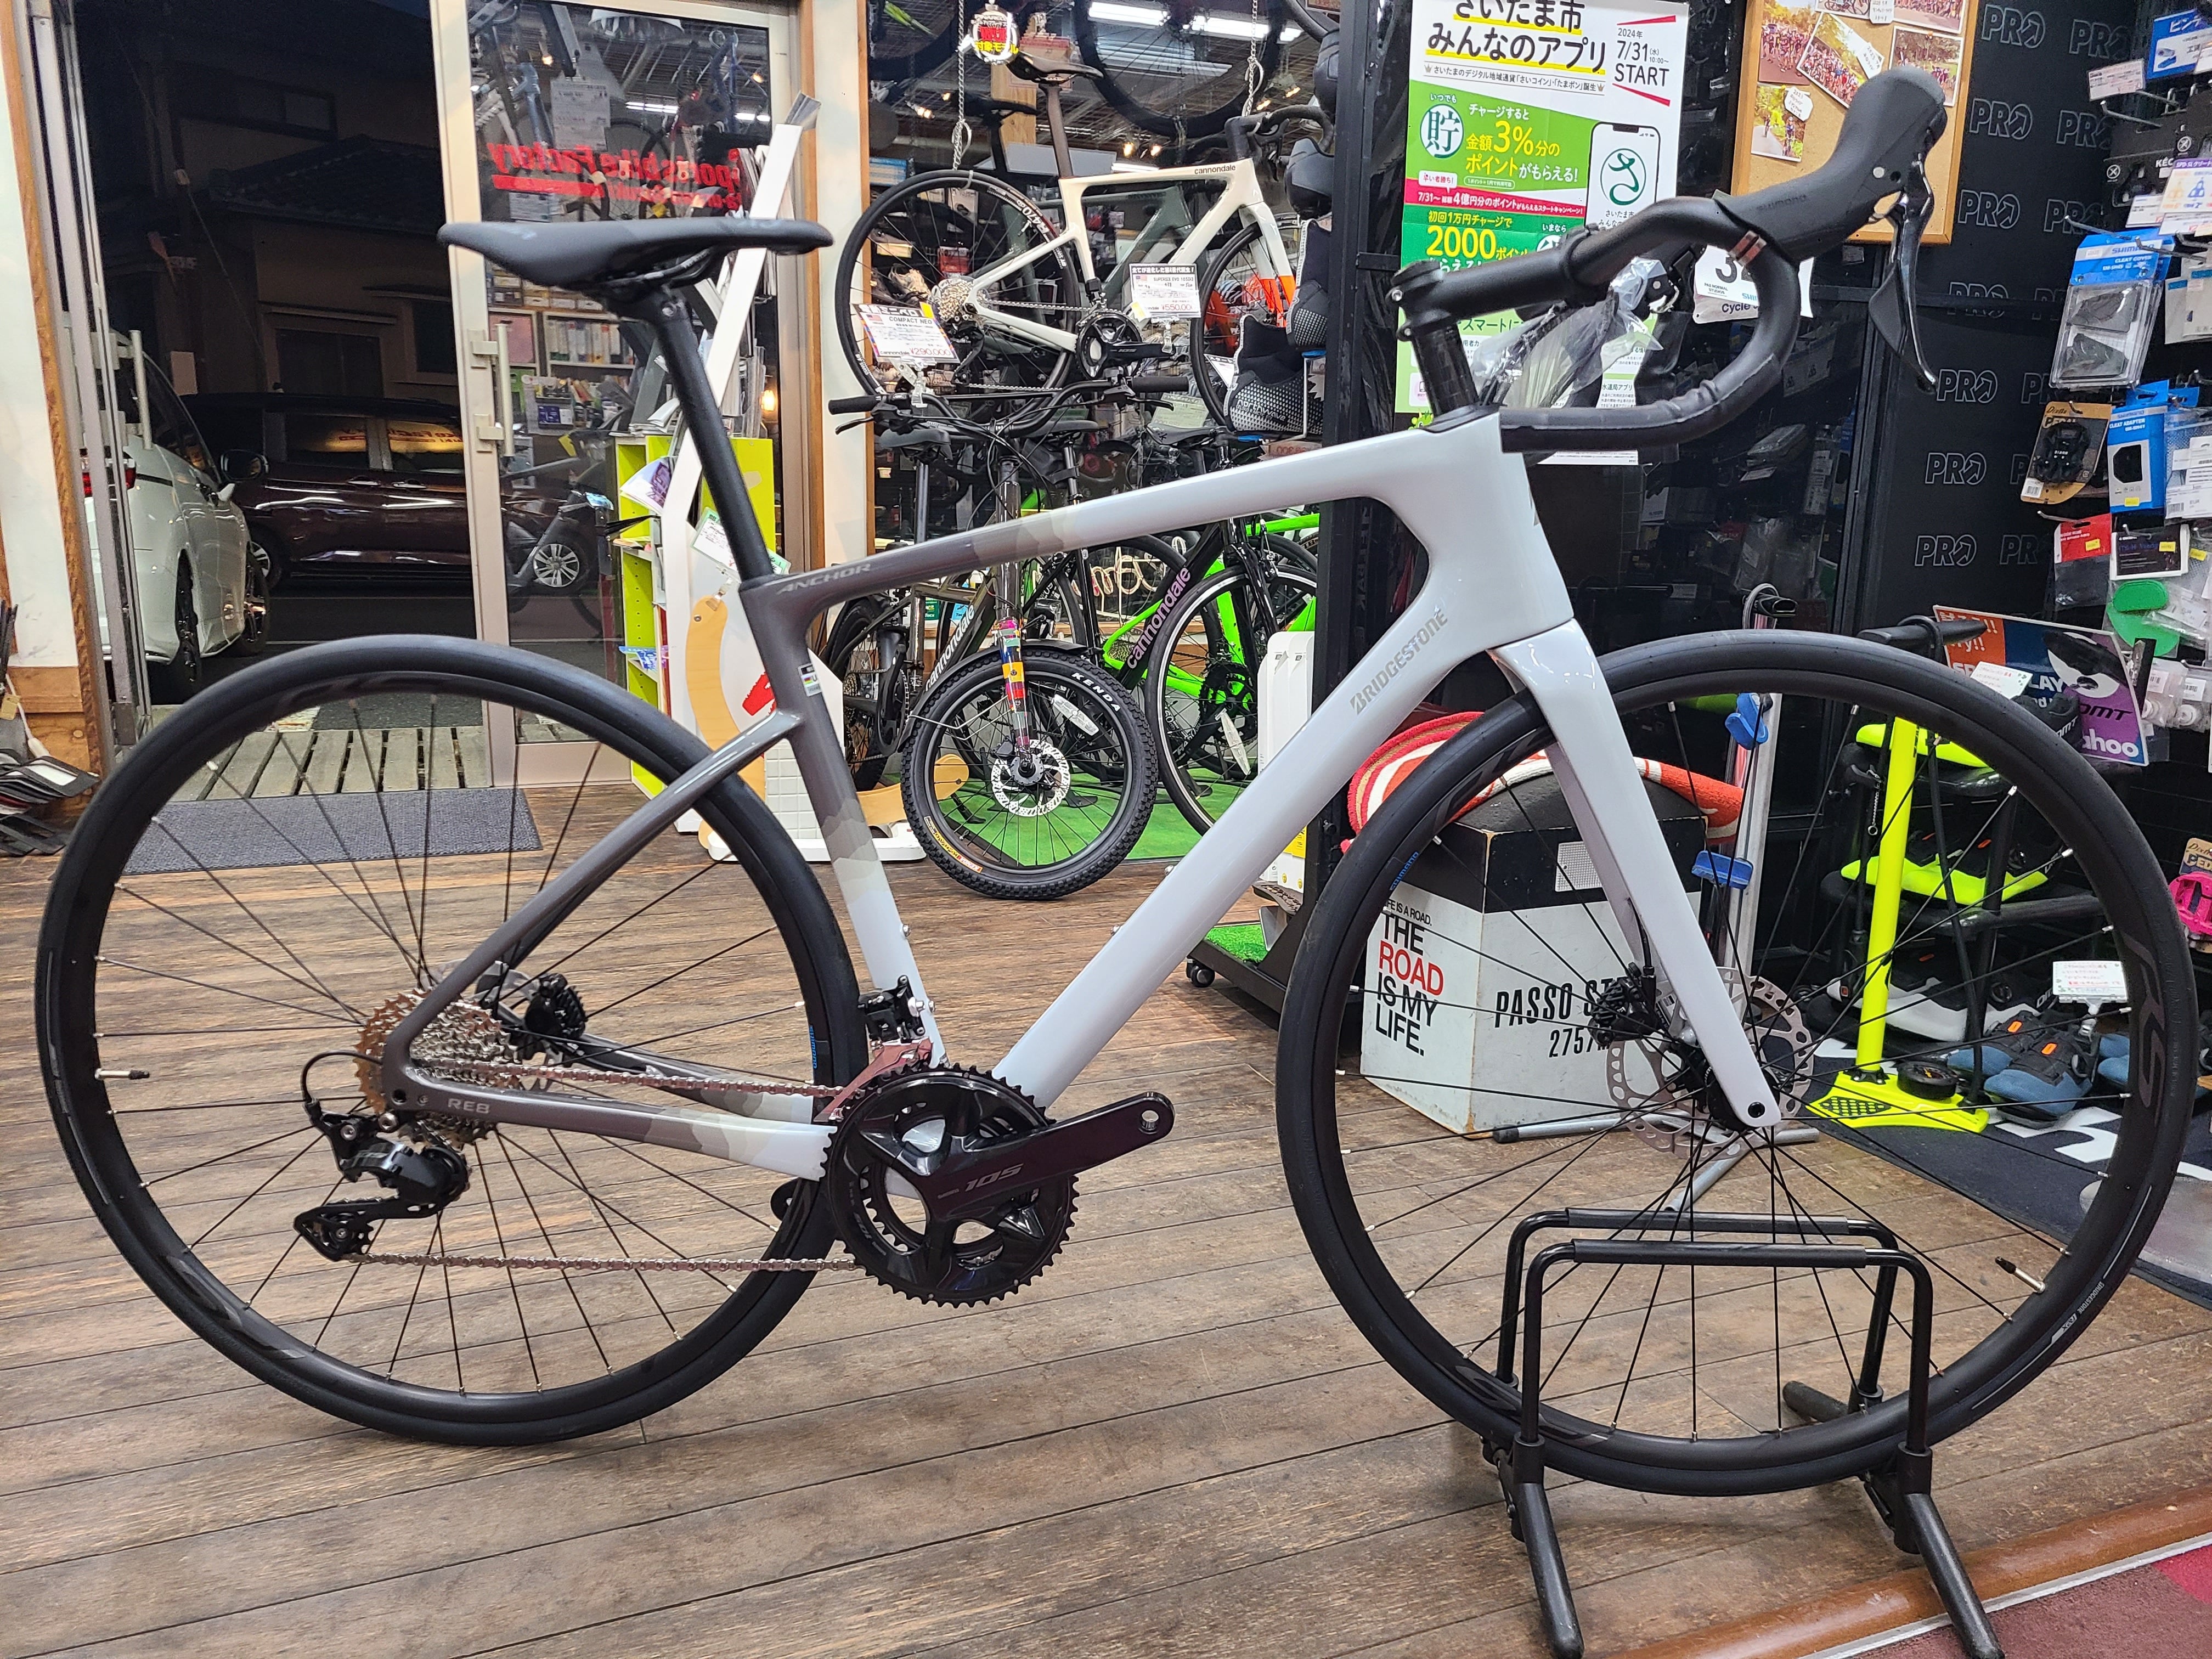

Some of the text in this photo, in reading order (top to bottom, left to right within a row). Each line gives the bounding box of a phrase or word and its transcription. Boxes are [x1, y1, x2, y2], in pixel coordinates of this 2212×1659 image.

[1617, 28, 1643, 38] 2024年
[1982, 4, 2045, 48] PRO
[1427, 23, 1606, 73] みんなのアプリ
[1617, 40, 1648, 62] 7/31
[1614, 63, 1670, 87] START
[1429, 93, 1457, 104] いつでも
[1468, 103, 1530, 120] チャージすると
[1426, 109, 1460, 153] 貯
[1969, 98, 2033, 139] PRO
[1194, 164, 1236, 175] cannondale
[1465, 154, 1578, 183] ポイントがもらえる!
[1427, 210, 1513, 228] 初回1万円チャージで
[1958, 189, 2021, 229] PRO
[1542, 223, 1566, 234] いまなら
[889, 316, 918, 325] COMPACT
[1937, 369, 1998, 404] PRO
[1925, 453, 1987, 485] PRO
[1915, 534, 1977, 566] PRO
[776, 563, 872, 595] ANCHOR
[1127, 567, 1192, 670] cannondale
[925, 603, 975, 692] cannondale
[1350, 610, 1448, 714] BRIDGESTONE
[1071, 672, 1121, 713] KENDA
[1396, 902, 1403, 913] IS
[1403, 906, 1409, 917] A
[1410, 908, 1432, 926] ROAD.
[1382, 912, 1425, 956] THE
[1378, 940, 1444, 996] ROAD
[1377, 971, 1439, 1028] IS MY
[1495, 982, 1572, 1028] PASSO
[1375, 1003, 1425, 1057] LIFE.
[447, 1098, 490, 1115] RE8
[964, 1163, 1024, 1192] 105
[2077, 1280, 2104, 1314] BRIDGESTONE
